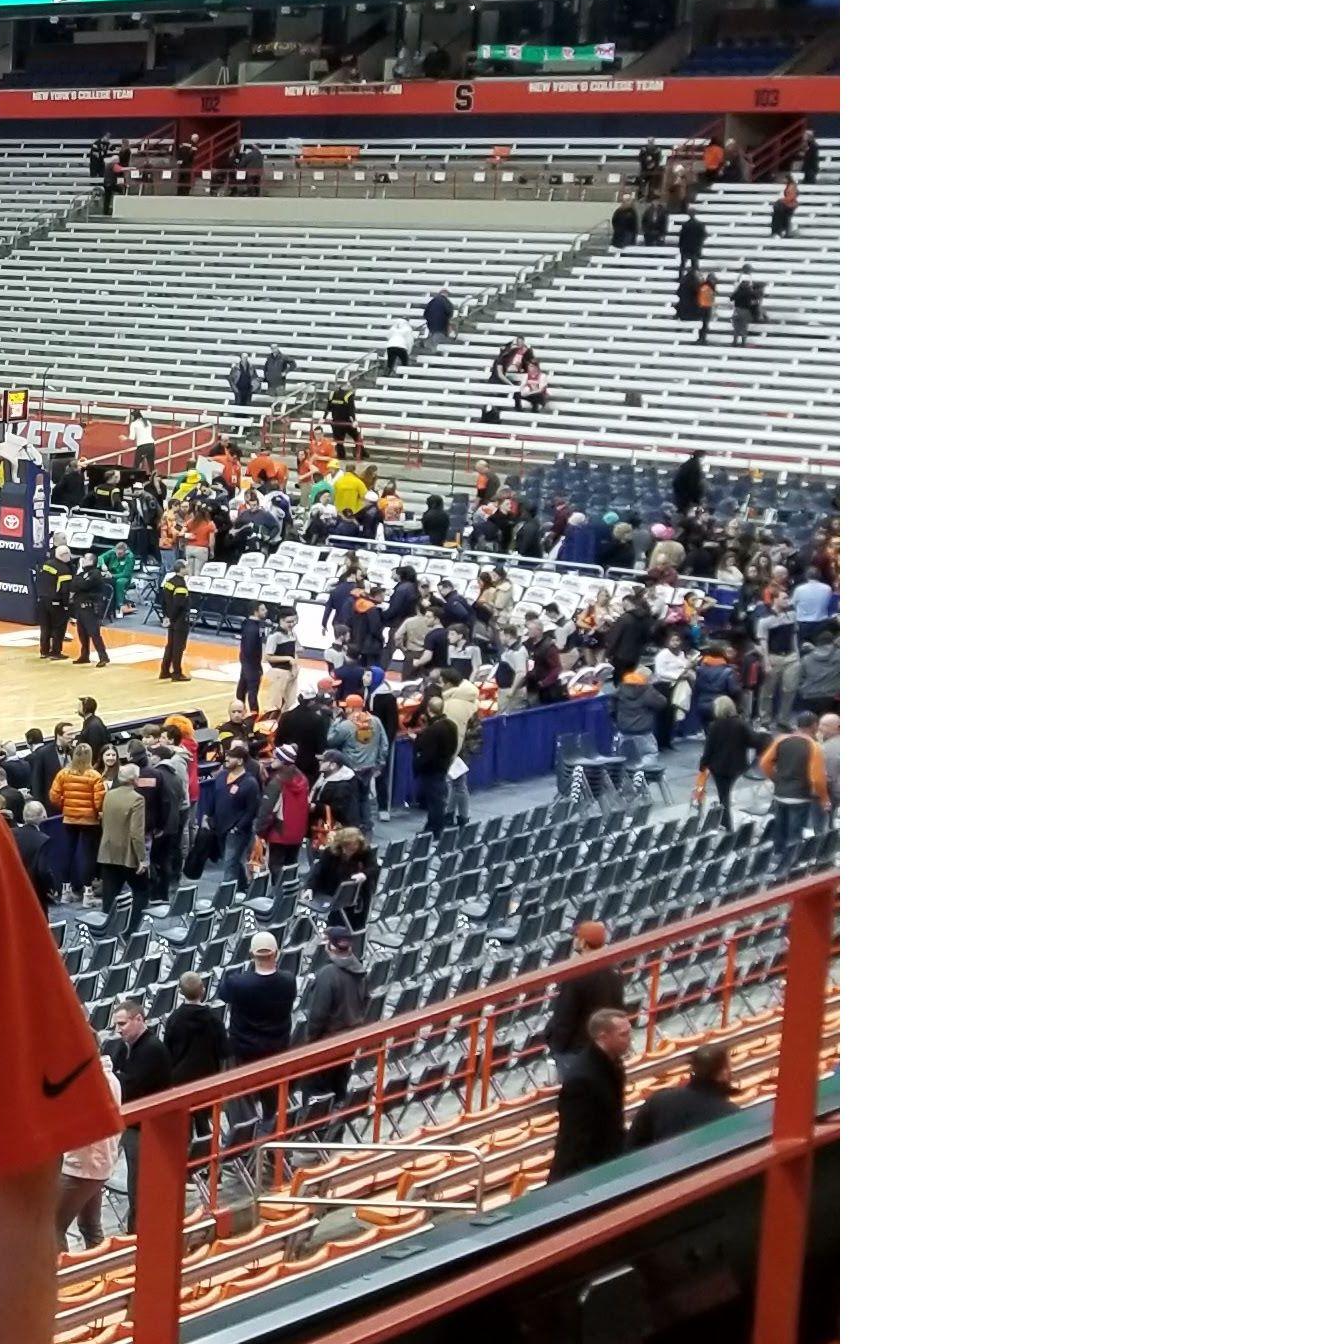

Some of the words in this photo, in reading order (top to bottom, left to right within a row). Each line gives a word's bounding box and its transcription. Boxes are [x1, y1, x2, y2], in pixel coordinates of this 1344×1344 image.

[284, 86, 304, 97] NEW
[528, 81, 550, 93] NEW
[32, 91, 49, 101] NEW
[454, 83, 475, 113] S
[200, 96, 221, 113] 102
